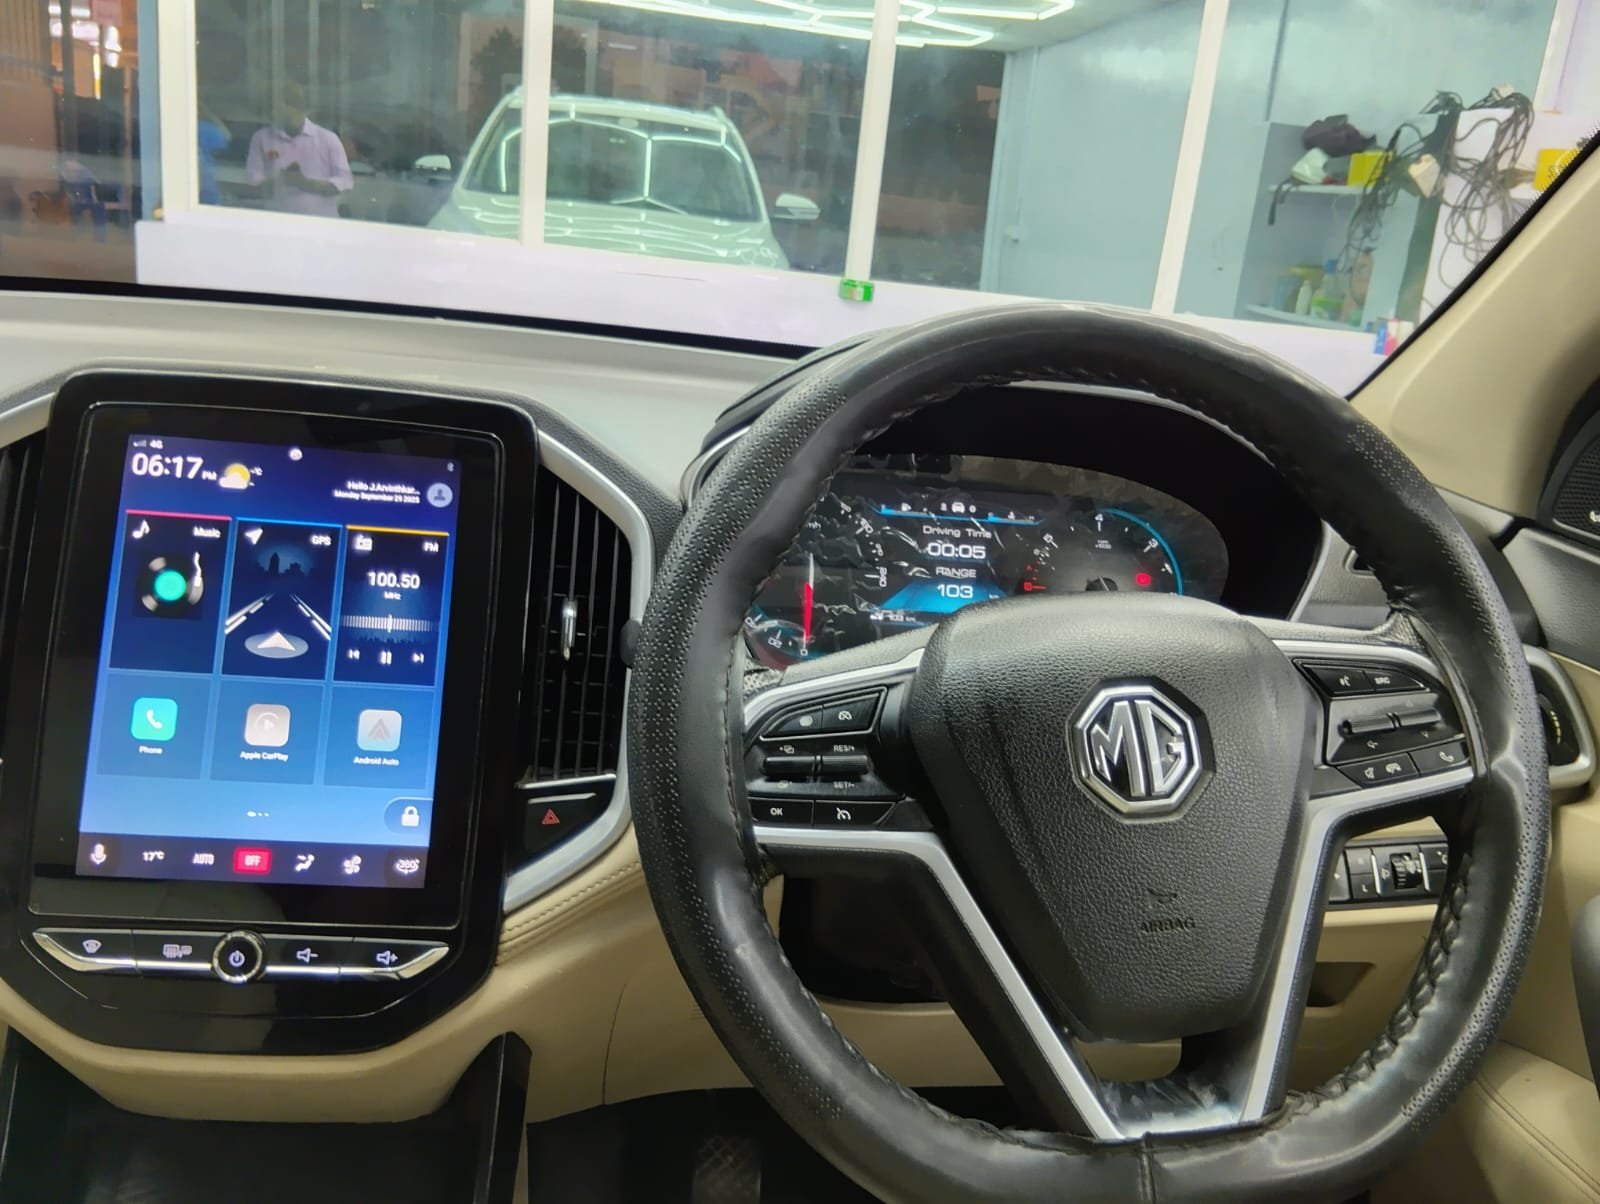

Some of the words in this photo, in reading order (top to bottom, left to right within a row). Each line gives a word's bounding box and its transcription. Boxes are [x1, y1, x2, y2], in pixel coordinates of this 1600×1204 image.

[149, 440, 163, 449] 4G
[132, 452, 204, 479] 06:17
[201, 470, 217, 480] PM
[346, 481, 369, 491] Hello
[334, 489, 360, 500] Monday
[361, 491, 393, 501] September
[193, 527, 221, 538] Music
[922, 525, 961, 538] Driving
[966, 528, 992, 539] Time
[310, 534, 332, 546] GPS
[424, 541, 439, 552] FM
[926, 542, 986, 559] 00:05
[935, 566, 977, 578] RANGE
[367, 571, 421, 589] 100.50
[383, 591, 401, 600] MHz
[937, 584, 974, 599] 103
[139, 745, 163, 755] Phone
[1090, 700, 1186, 797] MG
[240, 751, 261, 760] Apple
[262, 752, 288, 761] CarPlay
[353, 756, 382, 765] Android
[382, 758, 399, 766] Auto
[770, 807, 783, 815] OK
[192, 853, 215, 865] AUTO
[244, 854, 262, 866] OFF
[1141, 916, 1196, 935] AIRBAG
